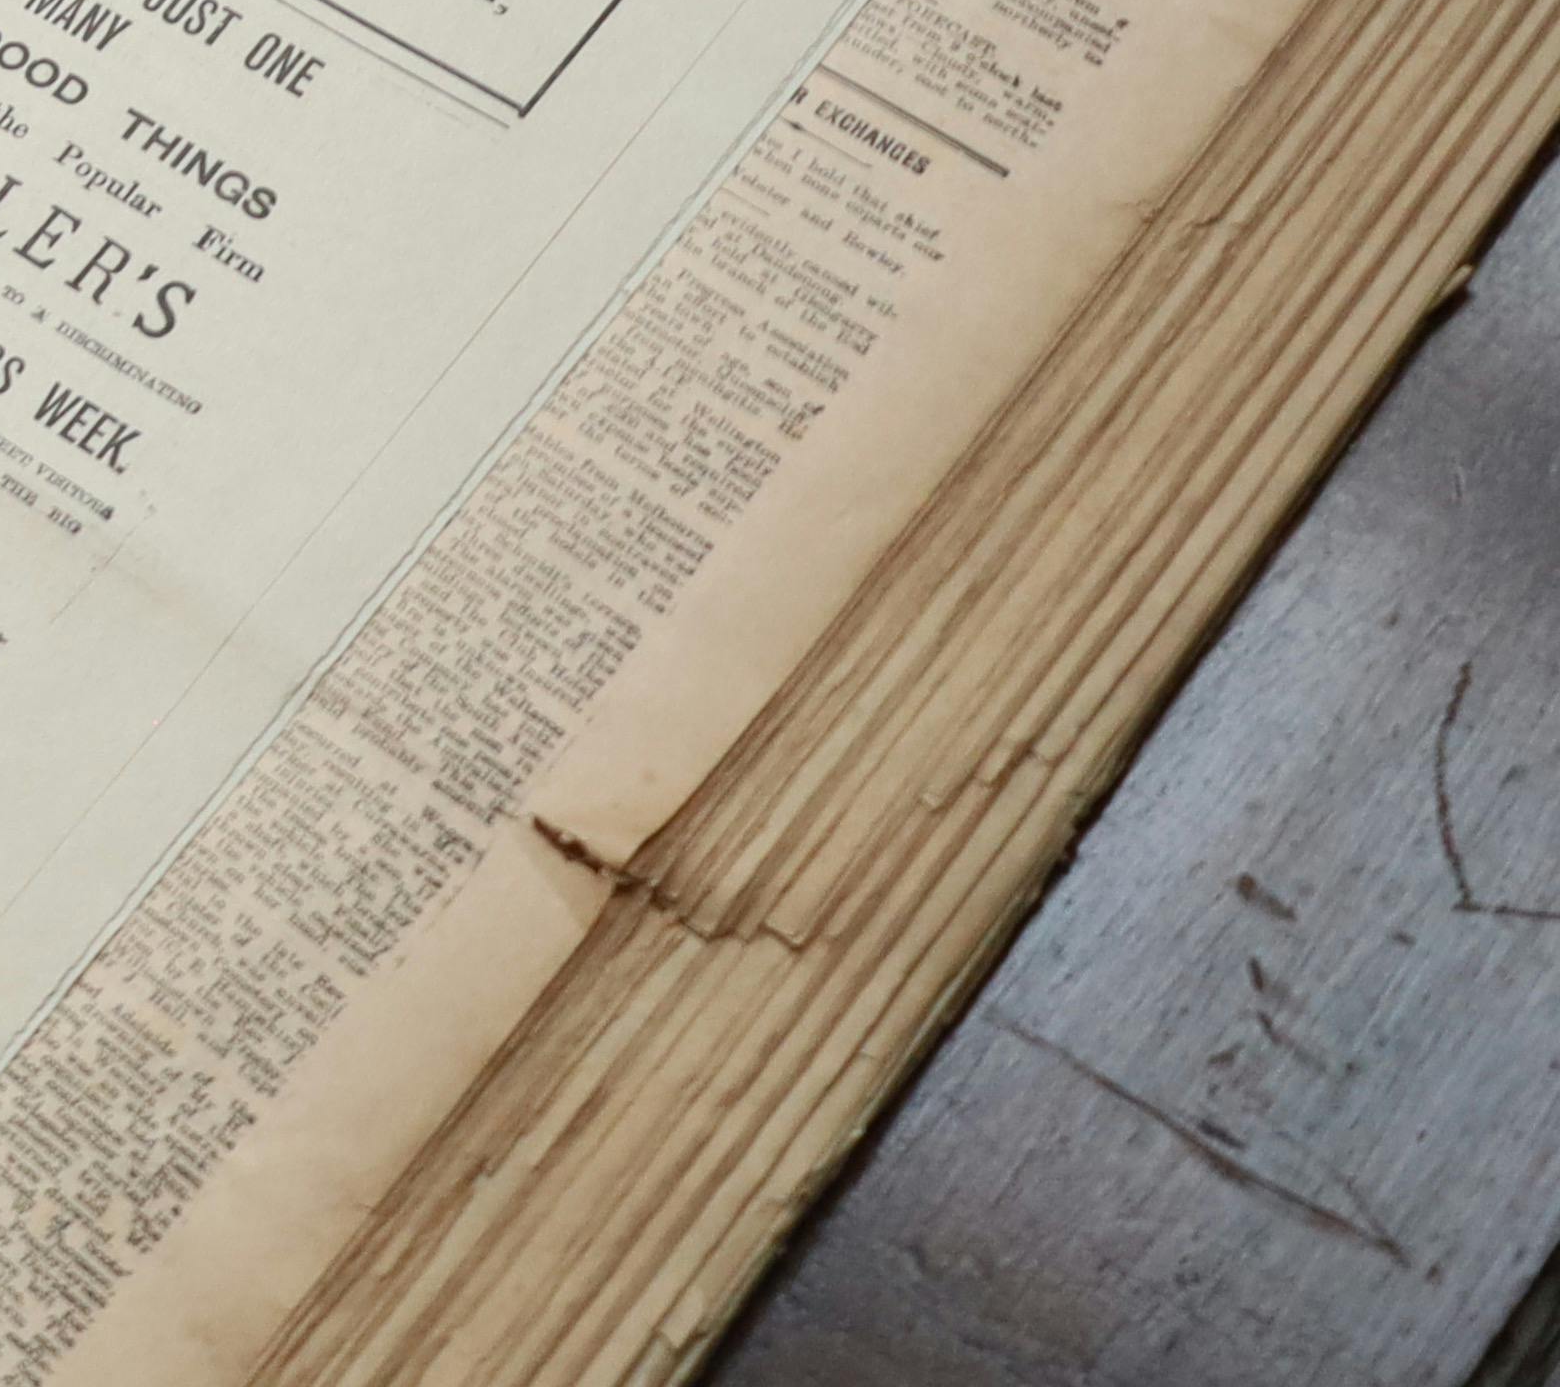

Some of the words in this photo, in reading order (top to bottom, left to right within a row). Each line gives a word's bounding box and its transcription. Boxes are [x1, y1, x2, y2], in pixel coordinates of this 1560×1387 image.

[242, 31, 327, 99] ONE
[120, 106, 279, 221] THINGS
[813, 99, 932, 177] EXCHANGES
[52, 141, 164, 219] Popular
[192, 224, 266, 284] Firm
[32, 380, 143, 476] WEEK.
